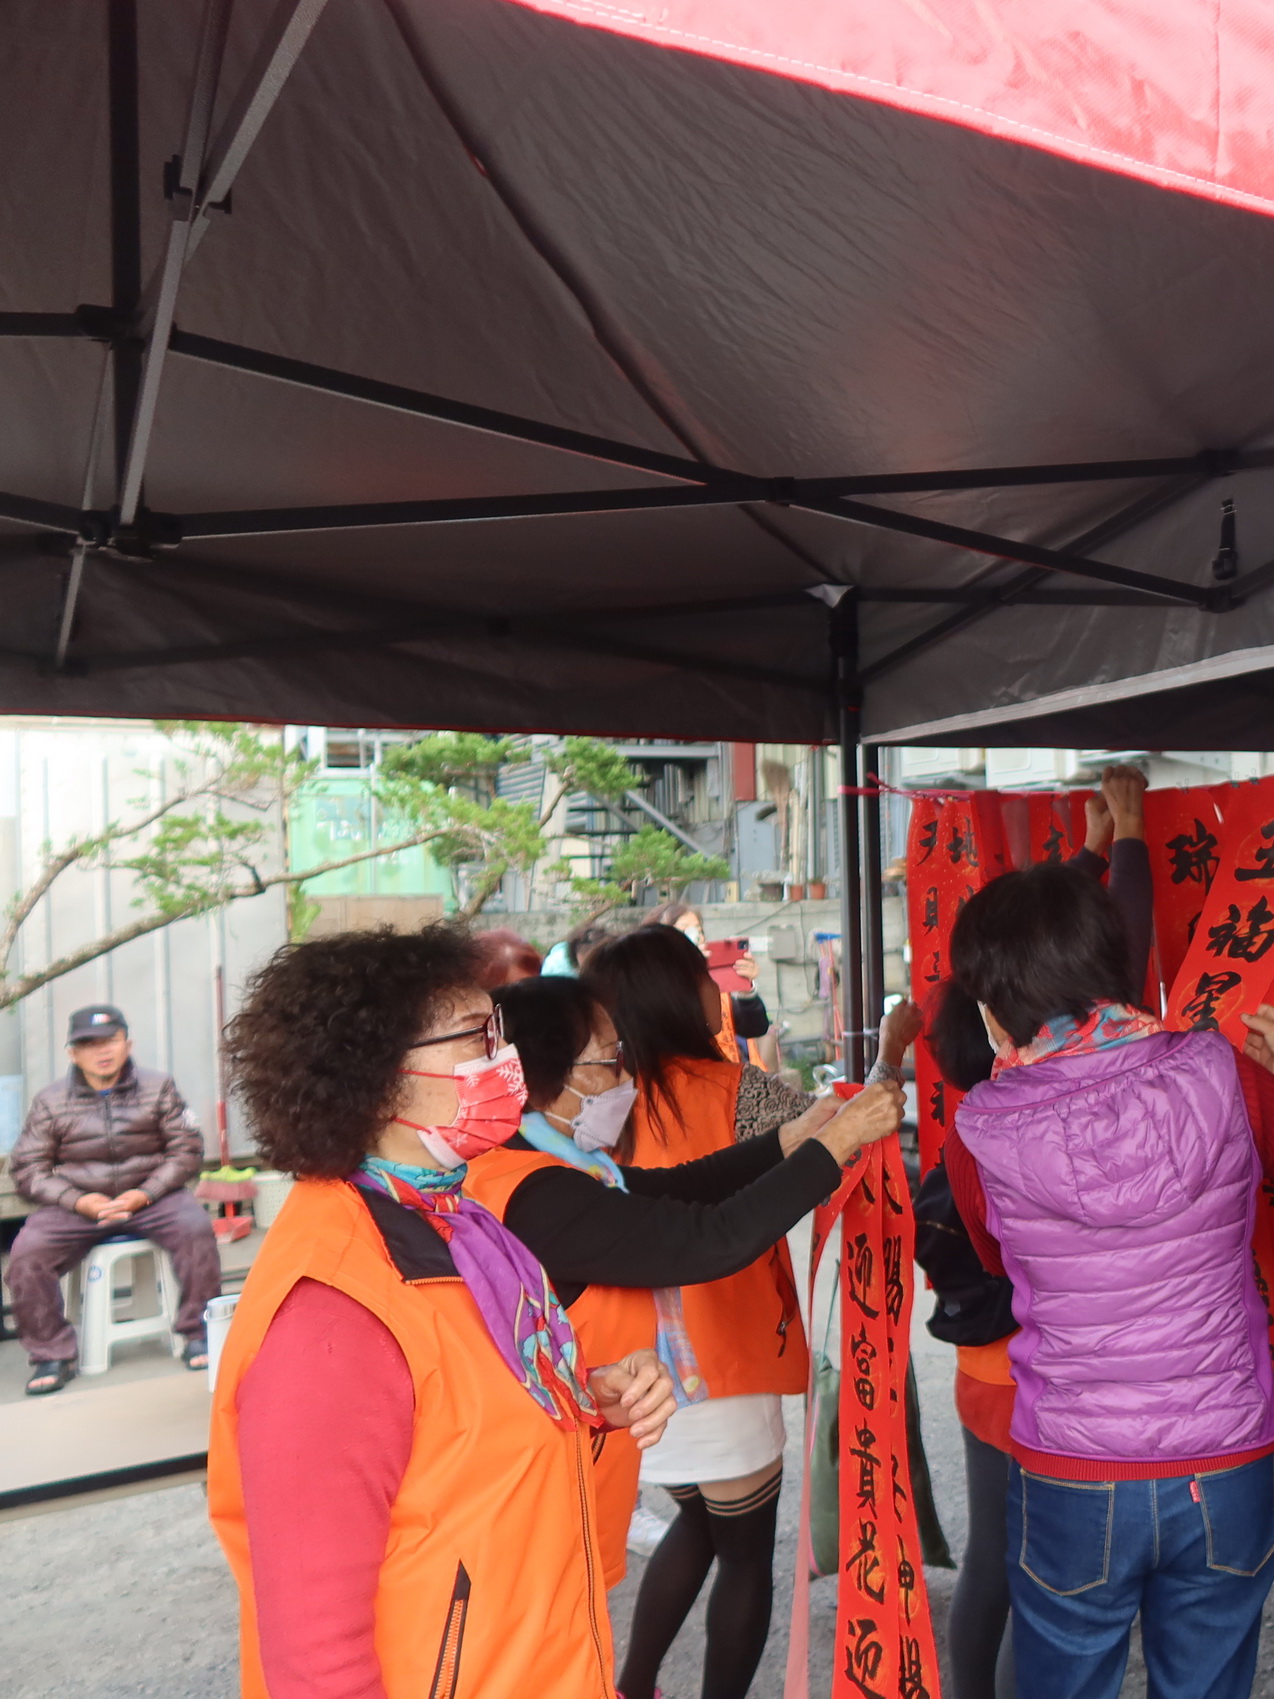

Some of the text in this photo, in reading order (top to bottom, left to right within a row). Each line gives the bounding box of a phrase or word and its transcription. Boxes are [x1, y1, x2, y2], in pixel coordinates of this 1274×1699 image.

[844, 1175, 889, 1699] 迎富貴花迎
